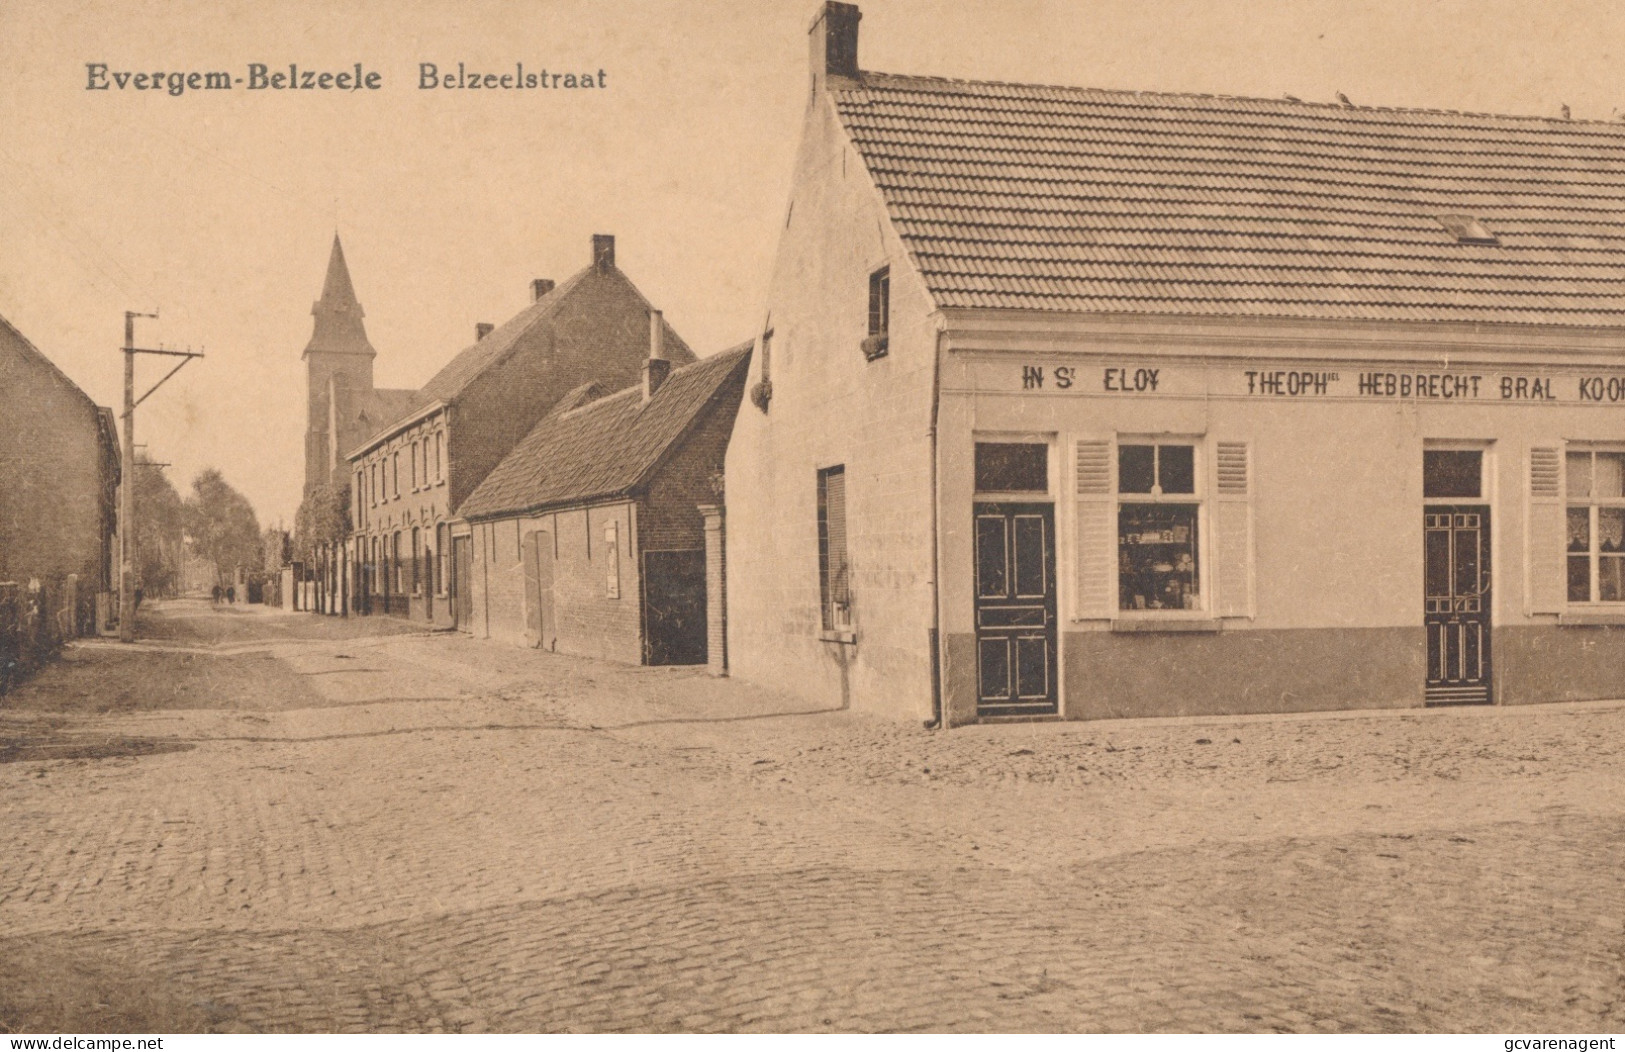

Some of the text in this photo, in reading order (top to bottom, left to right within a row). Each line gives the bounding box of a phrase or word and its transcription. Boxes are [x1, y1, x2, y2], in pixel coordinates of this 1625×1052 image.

[1022, 365, 1044, 389] IN
[1103, 367, 1160, 391] ELOY
[1358, 372, 1482, 398] HEBBRECHT
[1500, 376, 1556, 399] BRAL
